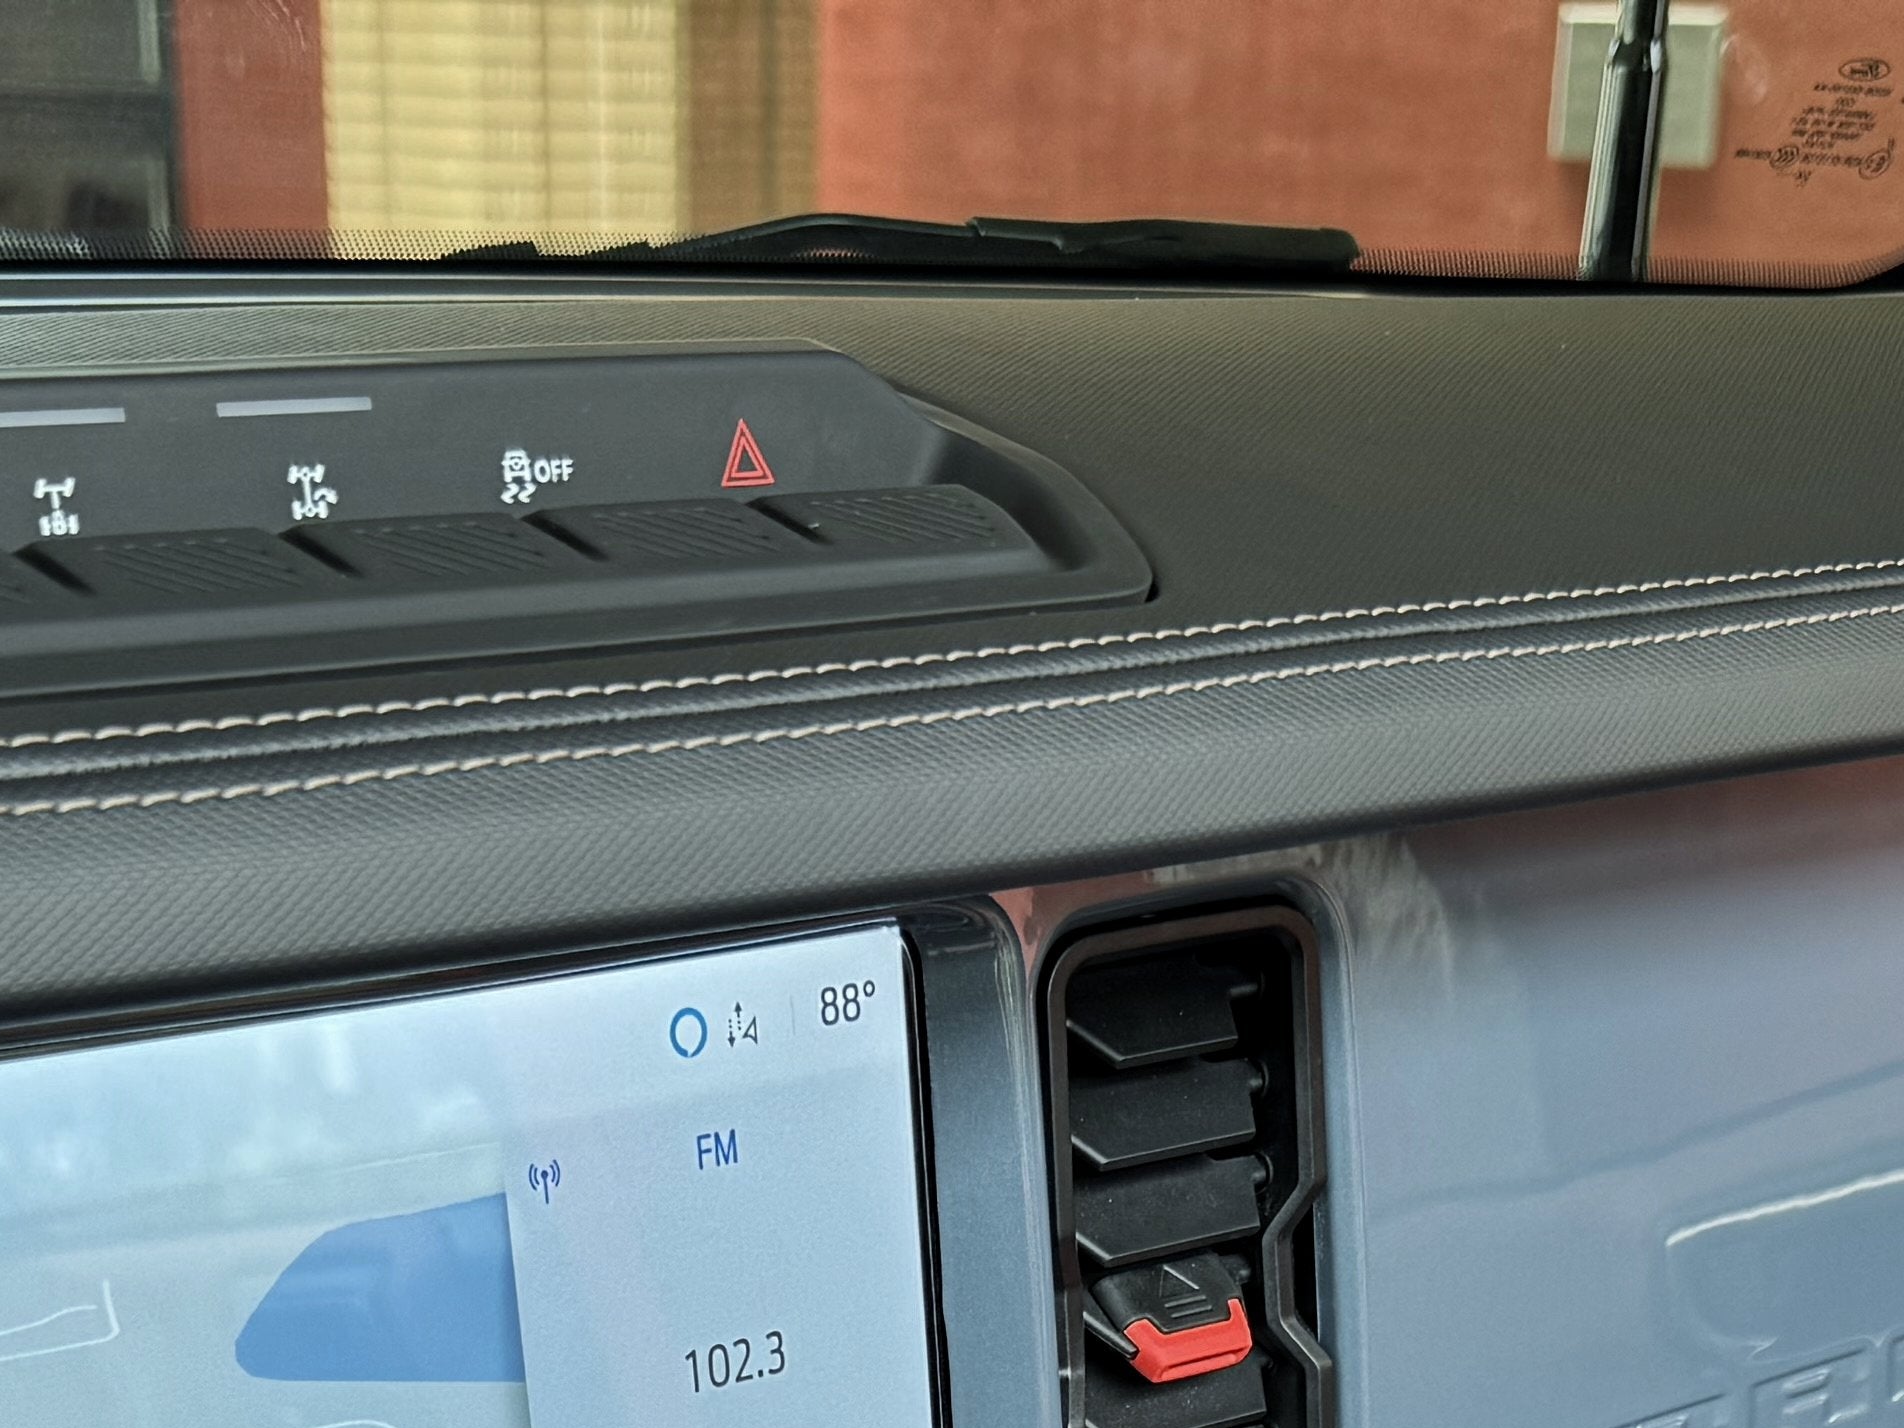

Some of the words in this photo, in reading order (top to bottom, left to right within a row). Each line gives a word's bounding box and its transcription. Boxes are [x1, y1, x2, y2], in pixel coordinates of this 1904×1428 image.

[534, 458, 575, 484] OFF
[695, 1128, 739, 1170] FM
[684, 1330, 786, 1393] 102.3
